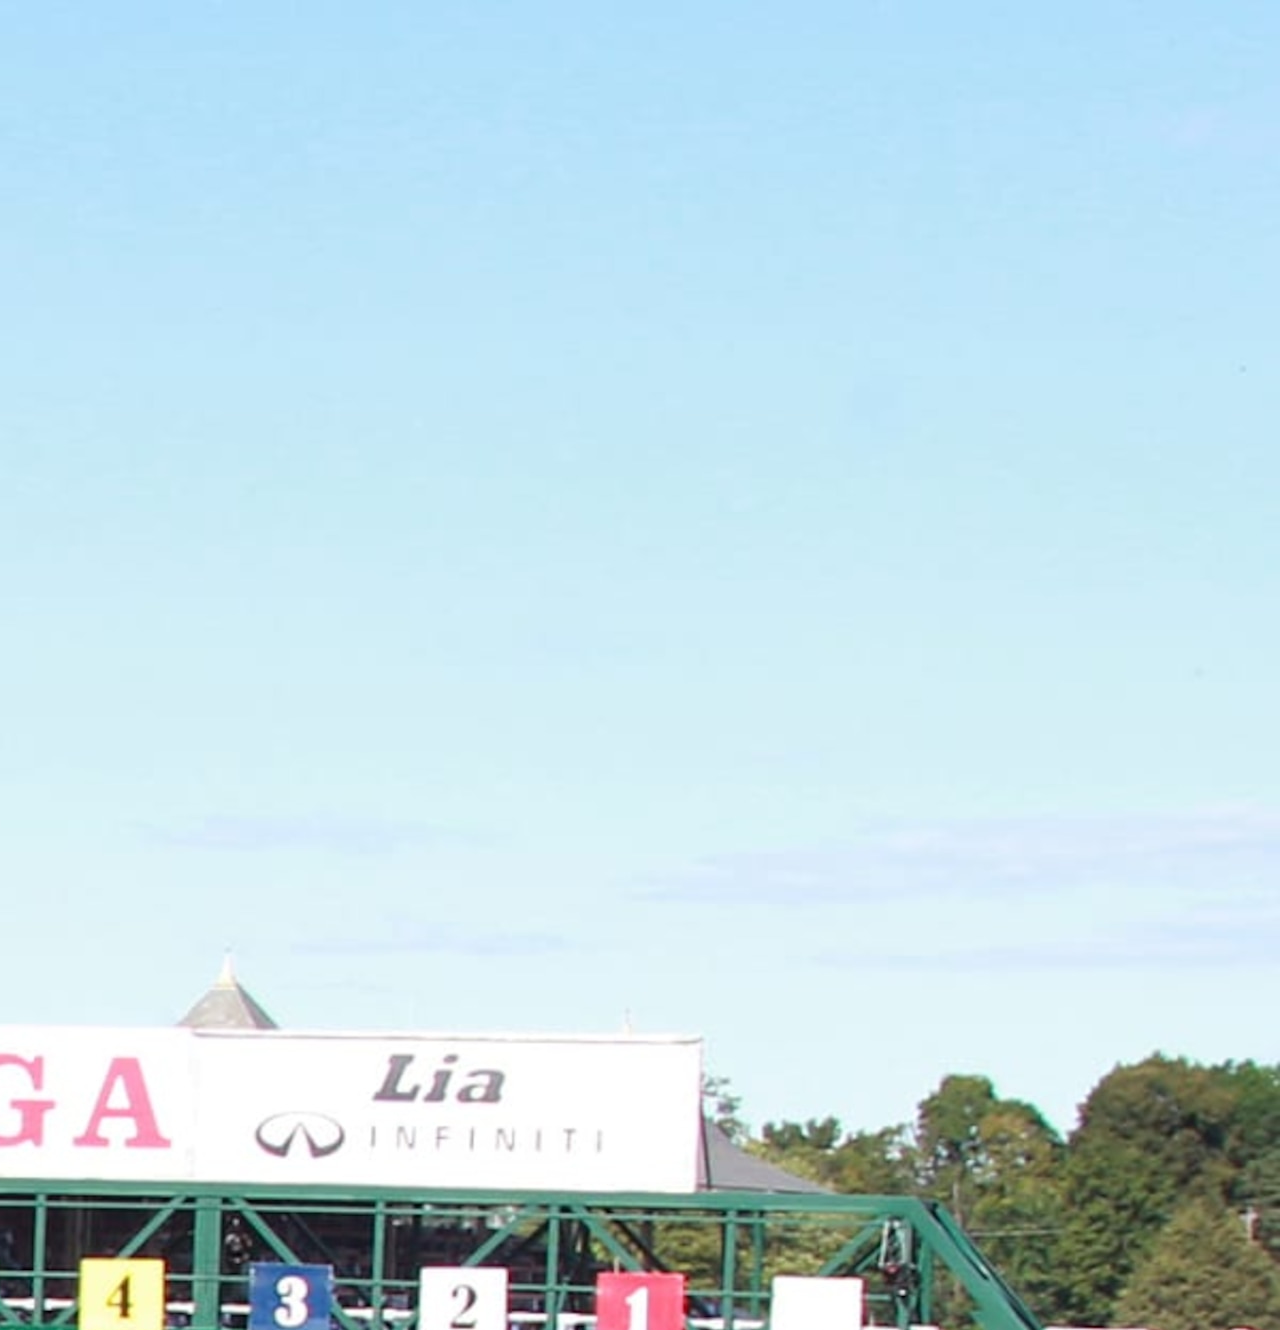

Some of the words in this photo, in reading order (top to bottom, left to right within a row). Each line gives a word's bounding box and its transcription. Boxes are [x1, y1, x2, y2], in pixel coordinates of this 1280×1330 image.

[373, 1053, 505, 1104] Lia
[369, 1126, 605, 1156] INFINITI
[106, 1276, 134, 1320] 4
[273, 1275, 310, 1326] 3
[448, 1281, 479, 1330] 2
